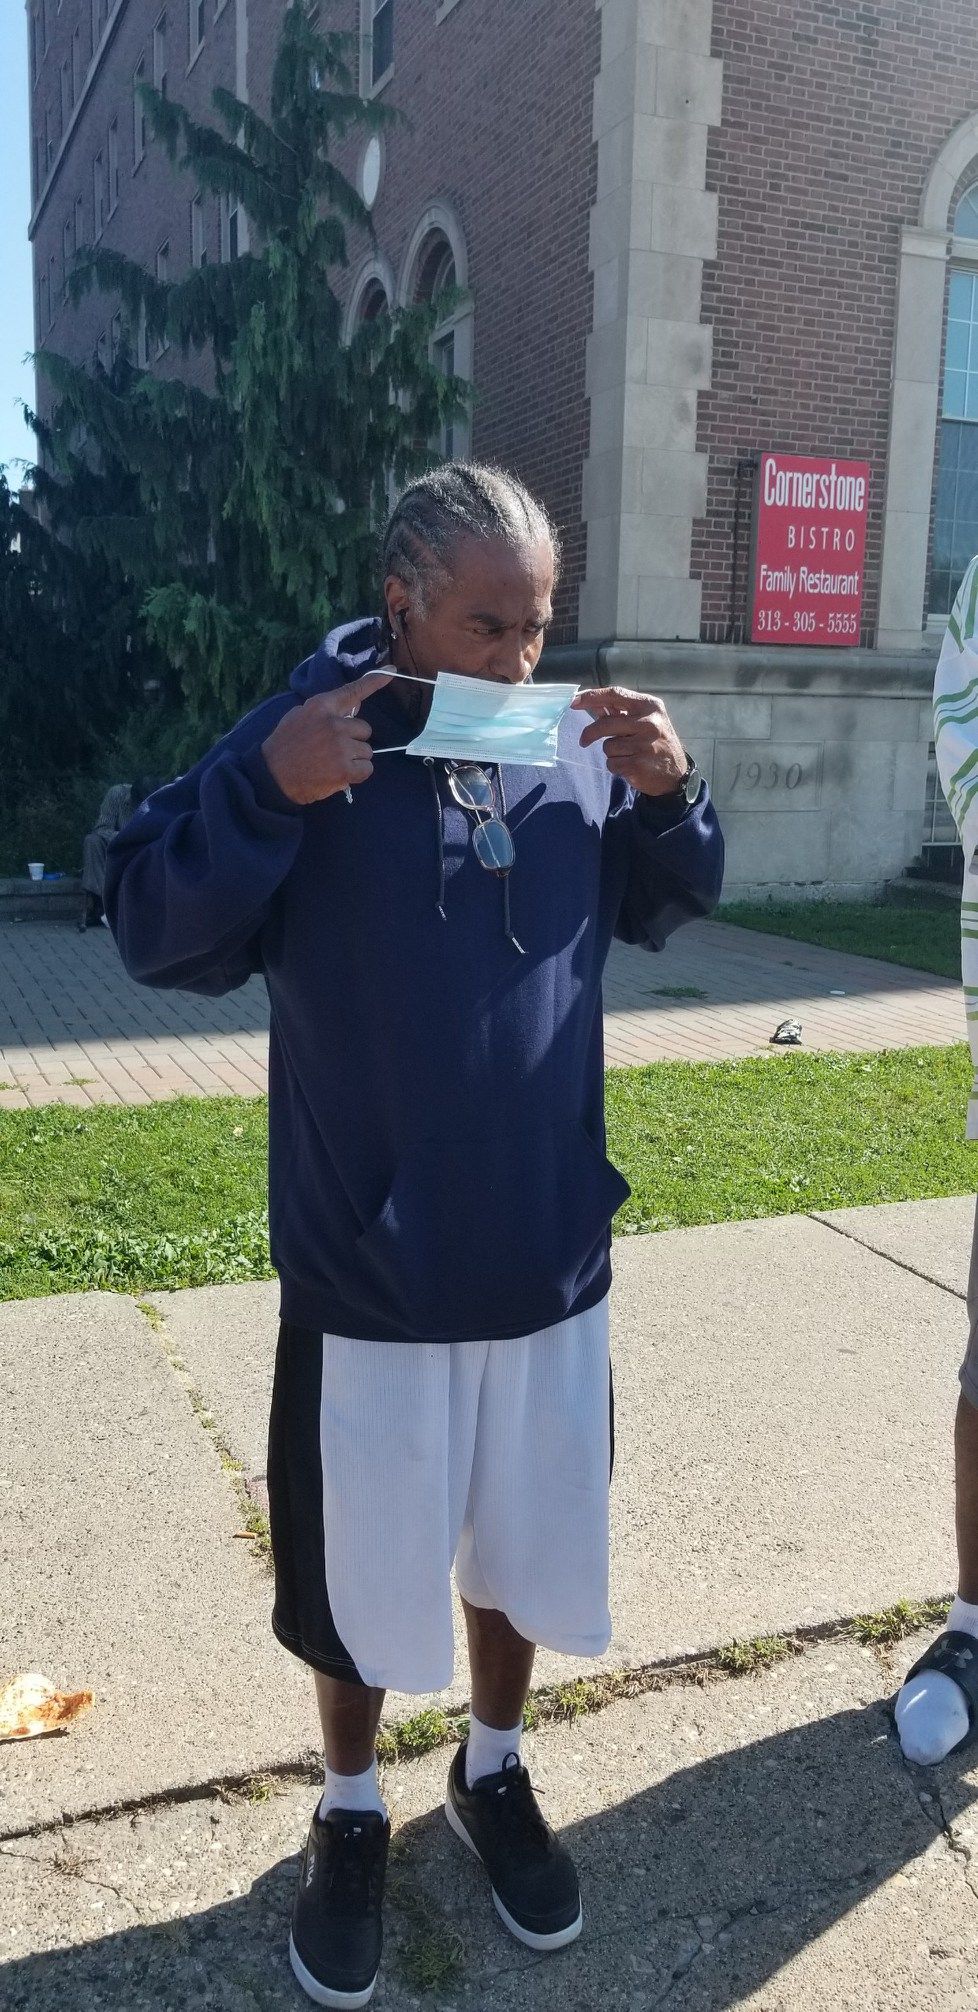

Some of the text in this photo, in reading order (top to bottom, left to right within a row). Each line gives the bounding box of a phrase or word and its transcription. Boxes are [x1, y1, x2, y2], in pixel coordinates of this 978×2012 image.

[764, 458, 865, 512] Cornerstone
[788, 525, 855, 551] BISTRO
[759, 565, 859, 599] Family Restaurant
[757, 610, 781, 631] 313
[792, 611, 816, 632] 305
[827, 612, 857, 633] 5555
[728, 762, 803, 792] 1930
